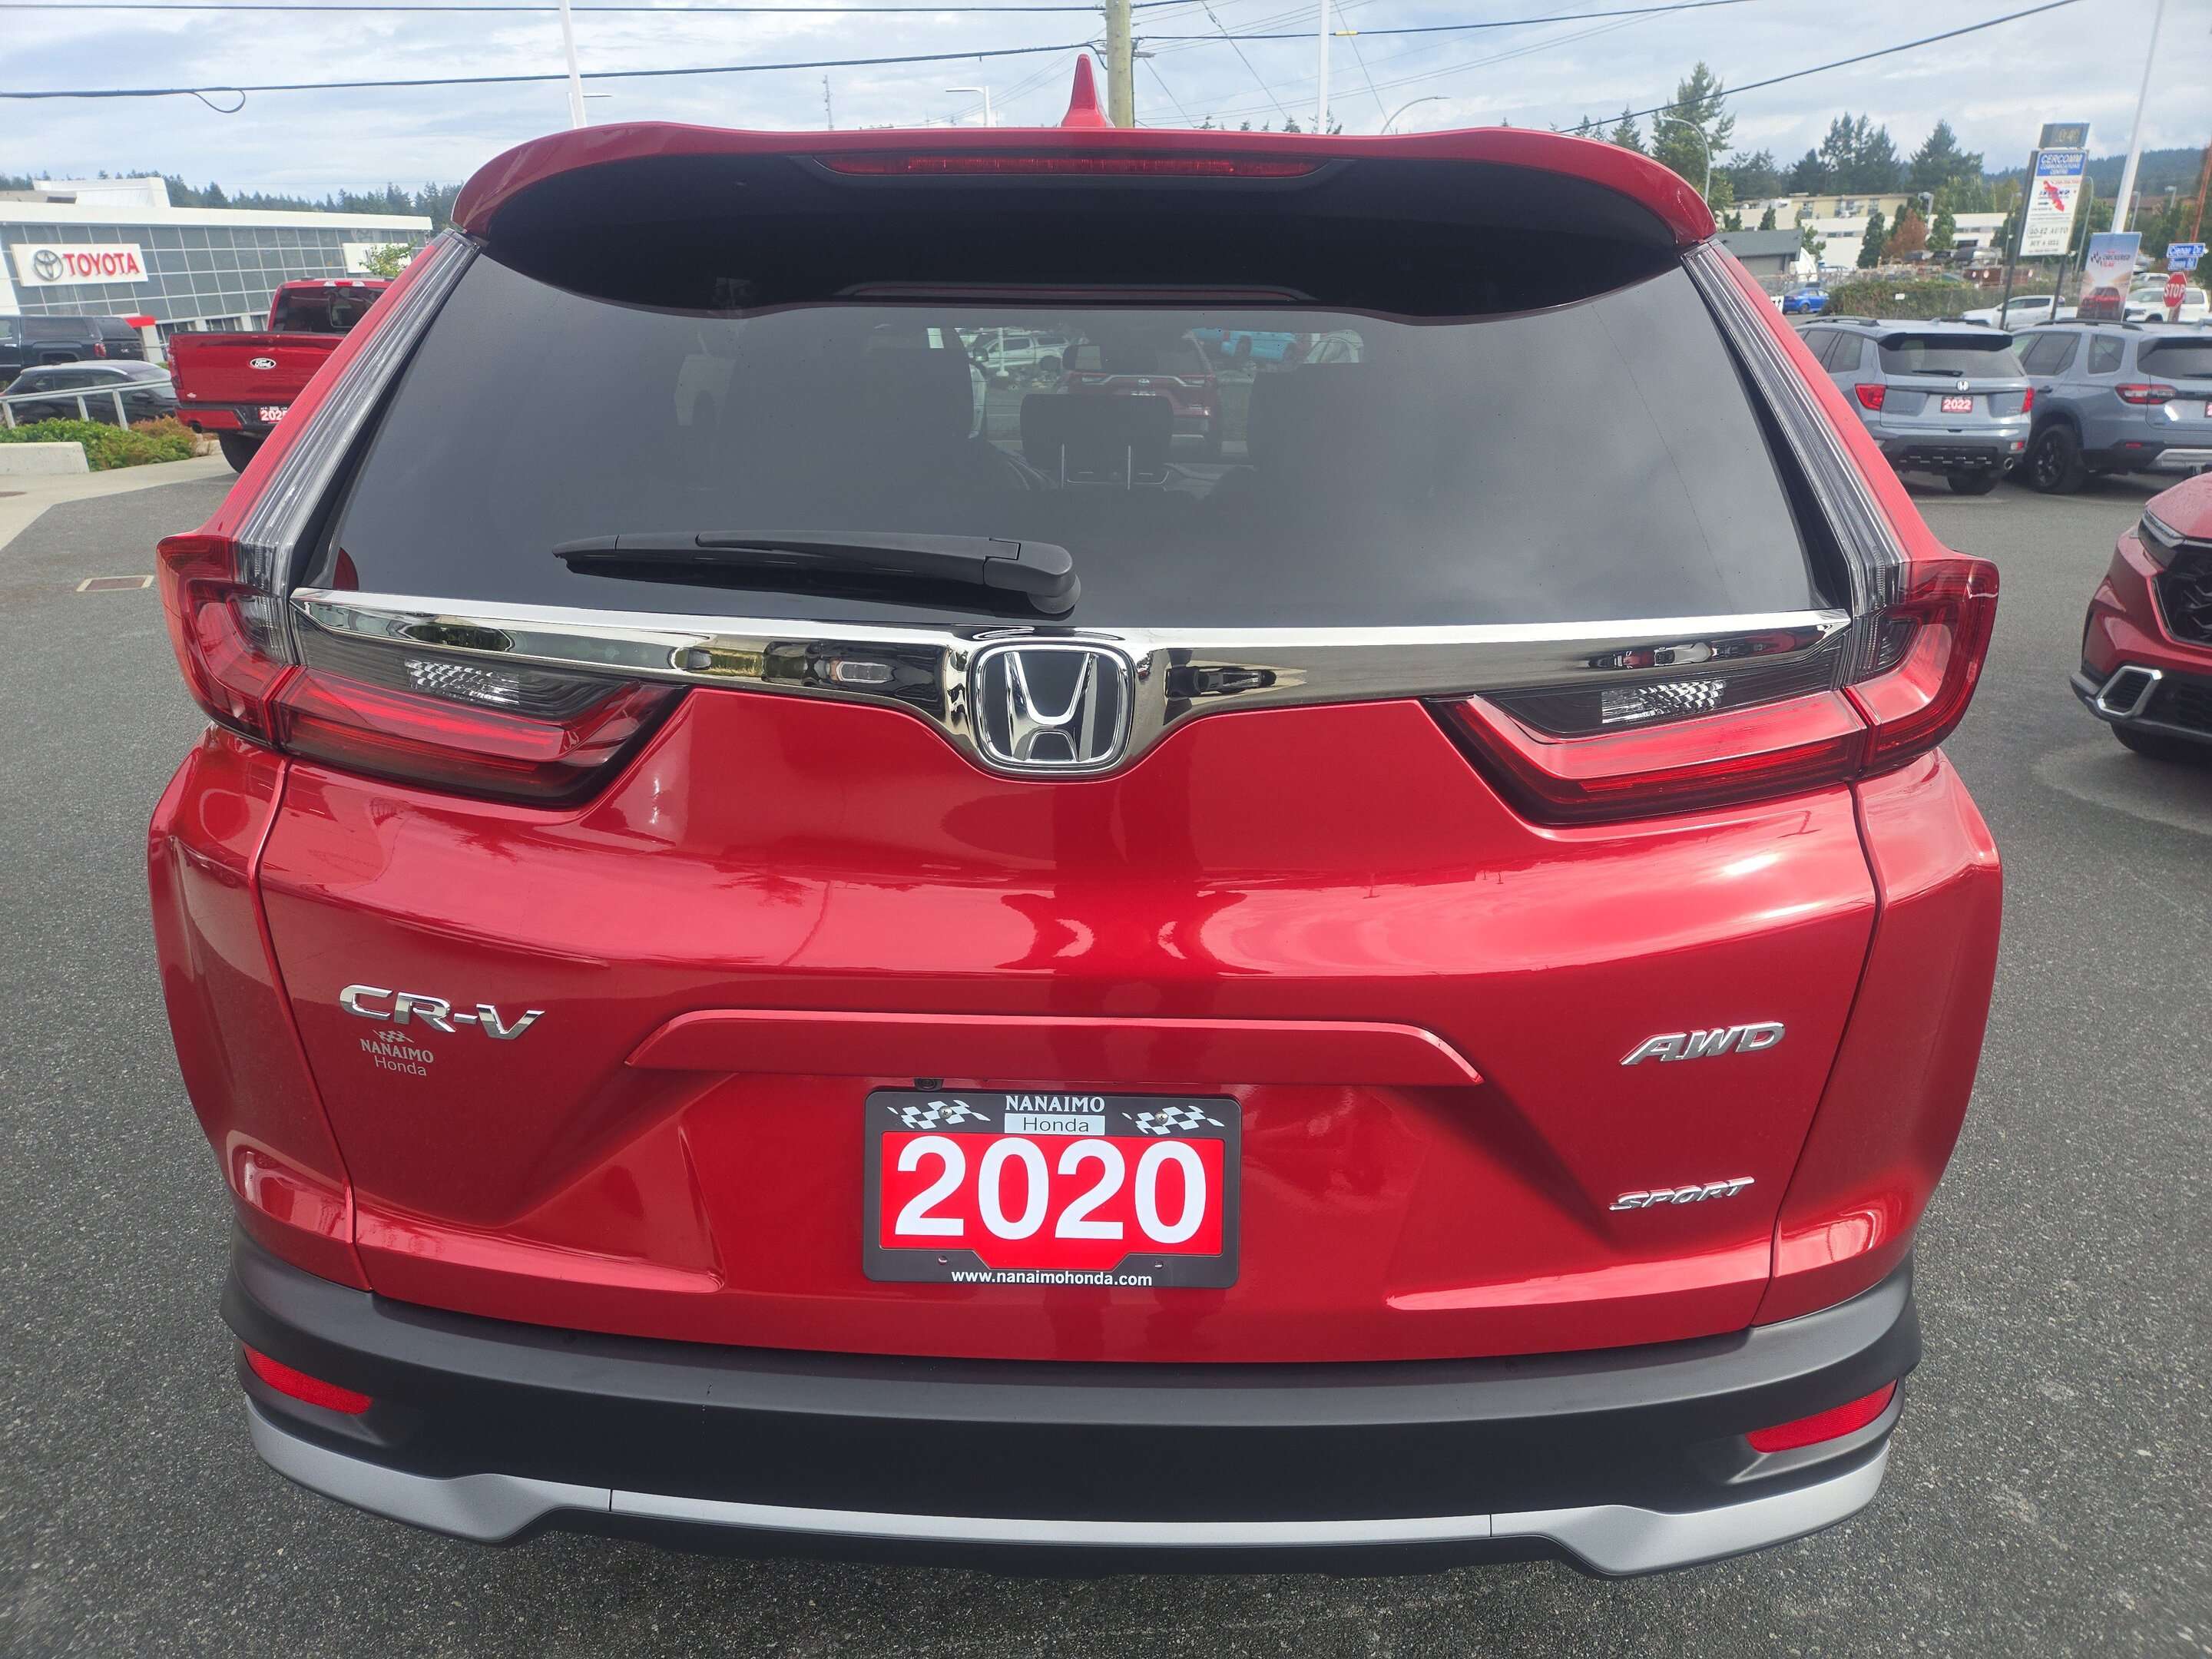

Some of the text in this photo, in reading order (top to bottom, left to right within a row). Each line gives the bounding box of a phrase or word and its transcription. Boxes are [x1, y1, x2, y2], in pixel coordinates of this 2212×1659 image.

[63, 253, 141, 276] TOYOTA
[2164, 283, 2185, 298] STOP
[1943, 399, 1972, 410] 2022
[339, 983, 545, 1040] CR-V
[359, 1038, 435, 1064] NANAIMO
[1619, 1021, 1786, 1066] AWD
[373, 1055, 427, 1077] Honda
[1005, 1094, 1106, 1112] NANAIMO
[1023, 1117, 1089, 1134] Honda
[895, 1135, 1207, 1244] 2020
[1609, 1176, 1755, 1211] SPORT
[951, 1270, 1152, 1286] www.nanaimohonda.com
